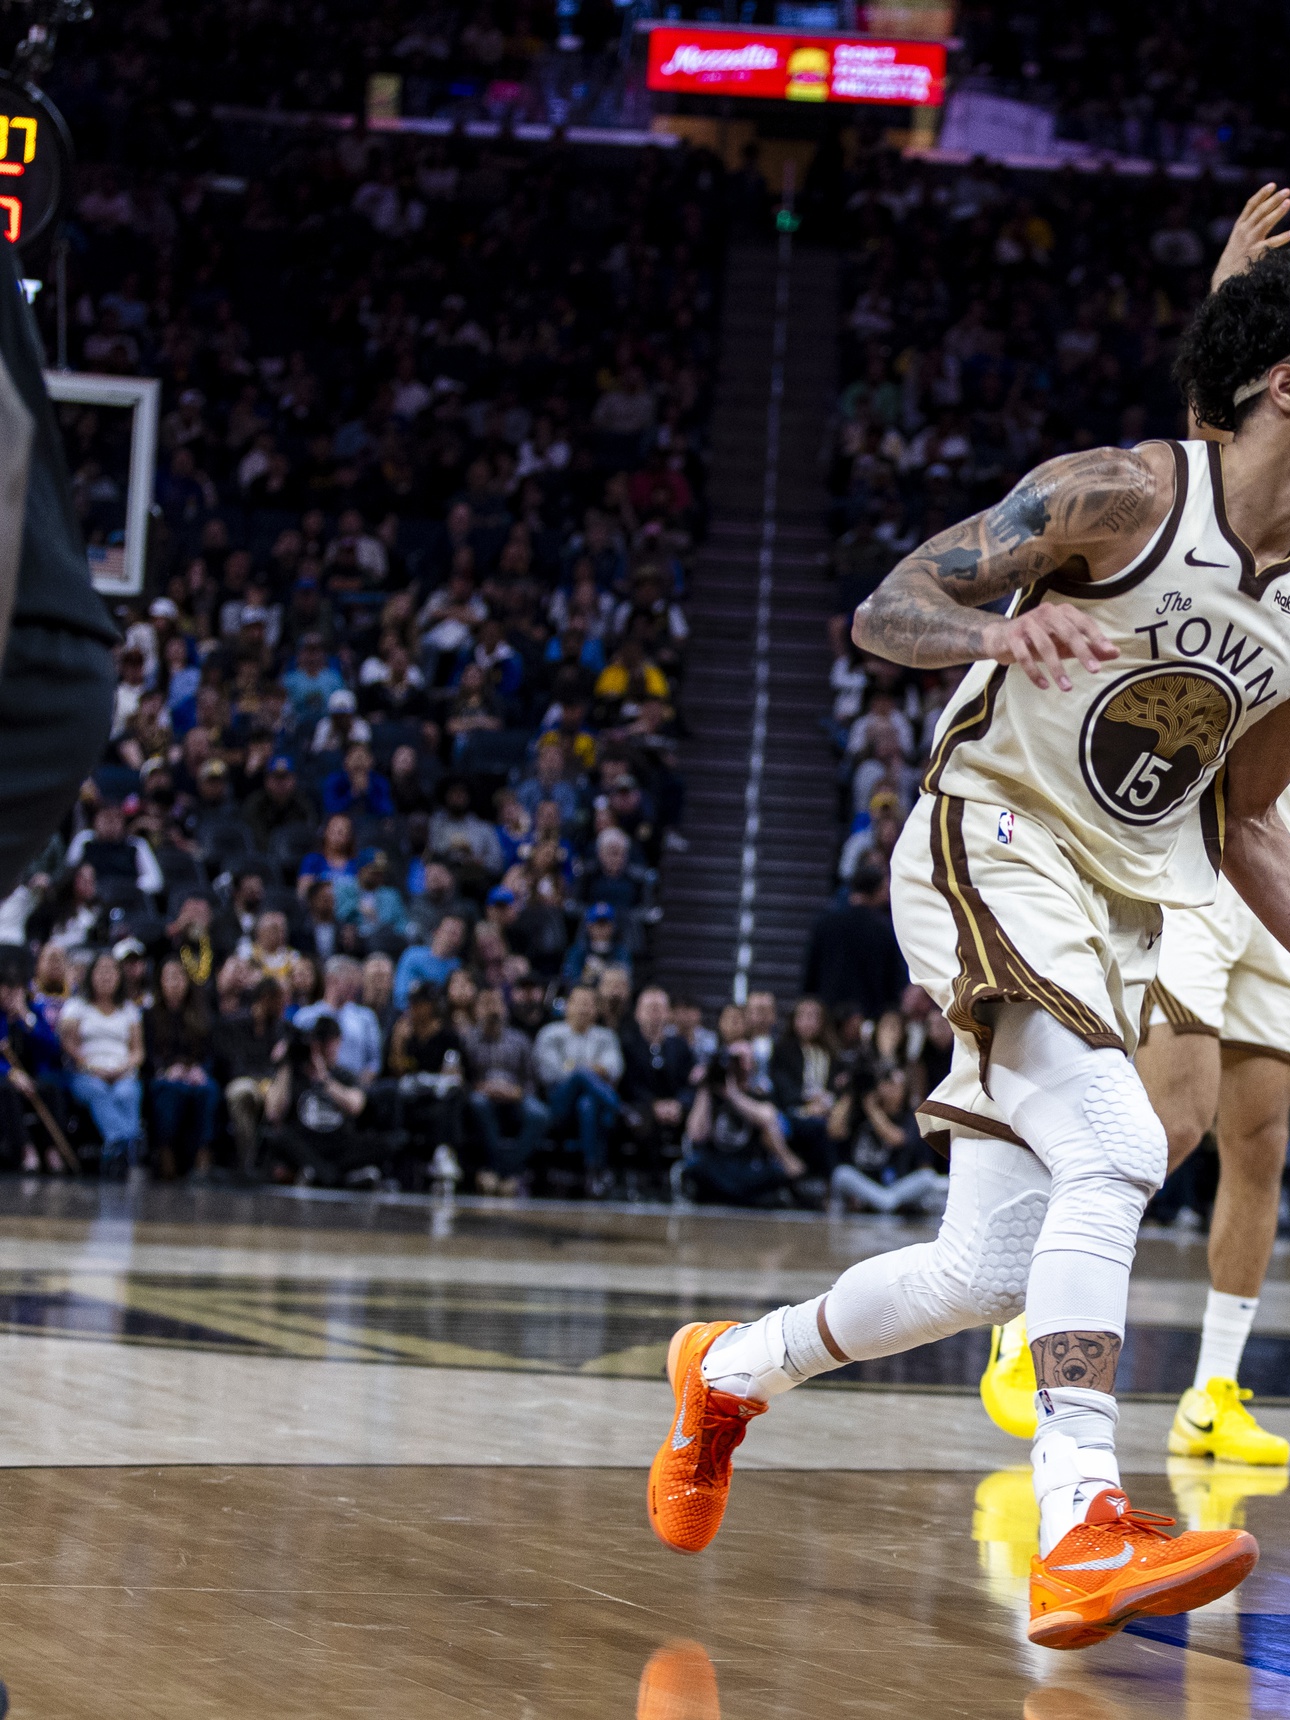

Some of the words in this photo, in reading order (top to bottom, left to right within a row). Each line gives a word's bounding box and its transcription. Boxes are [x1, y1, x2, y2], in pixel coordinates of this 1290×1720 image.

[1156, 590, 1192, 615] The
[1134, 617, 1278, 712] TOWN
[1115, 751, 1173, 807] 15
